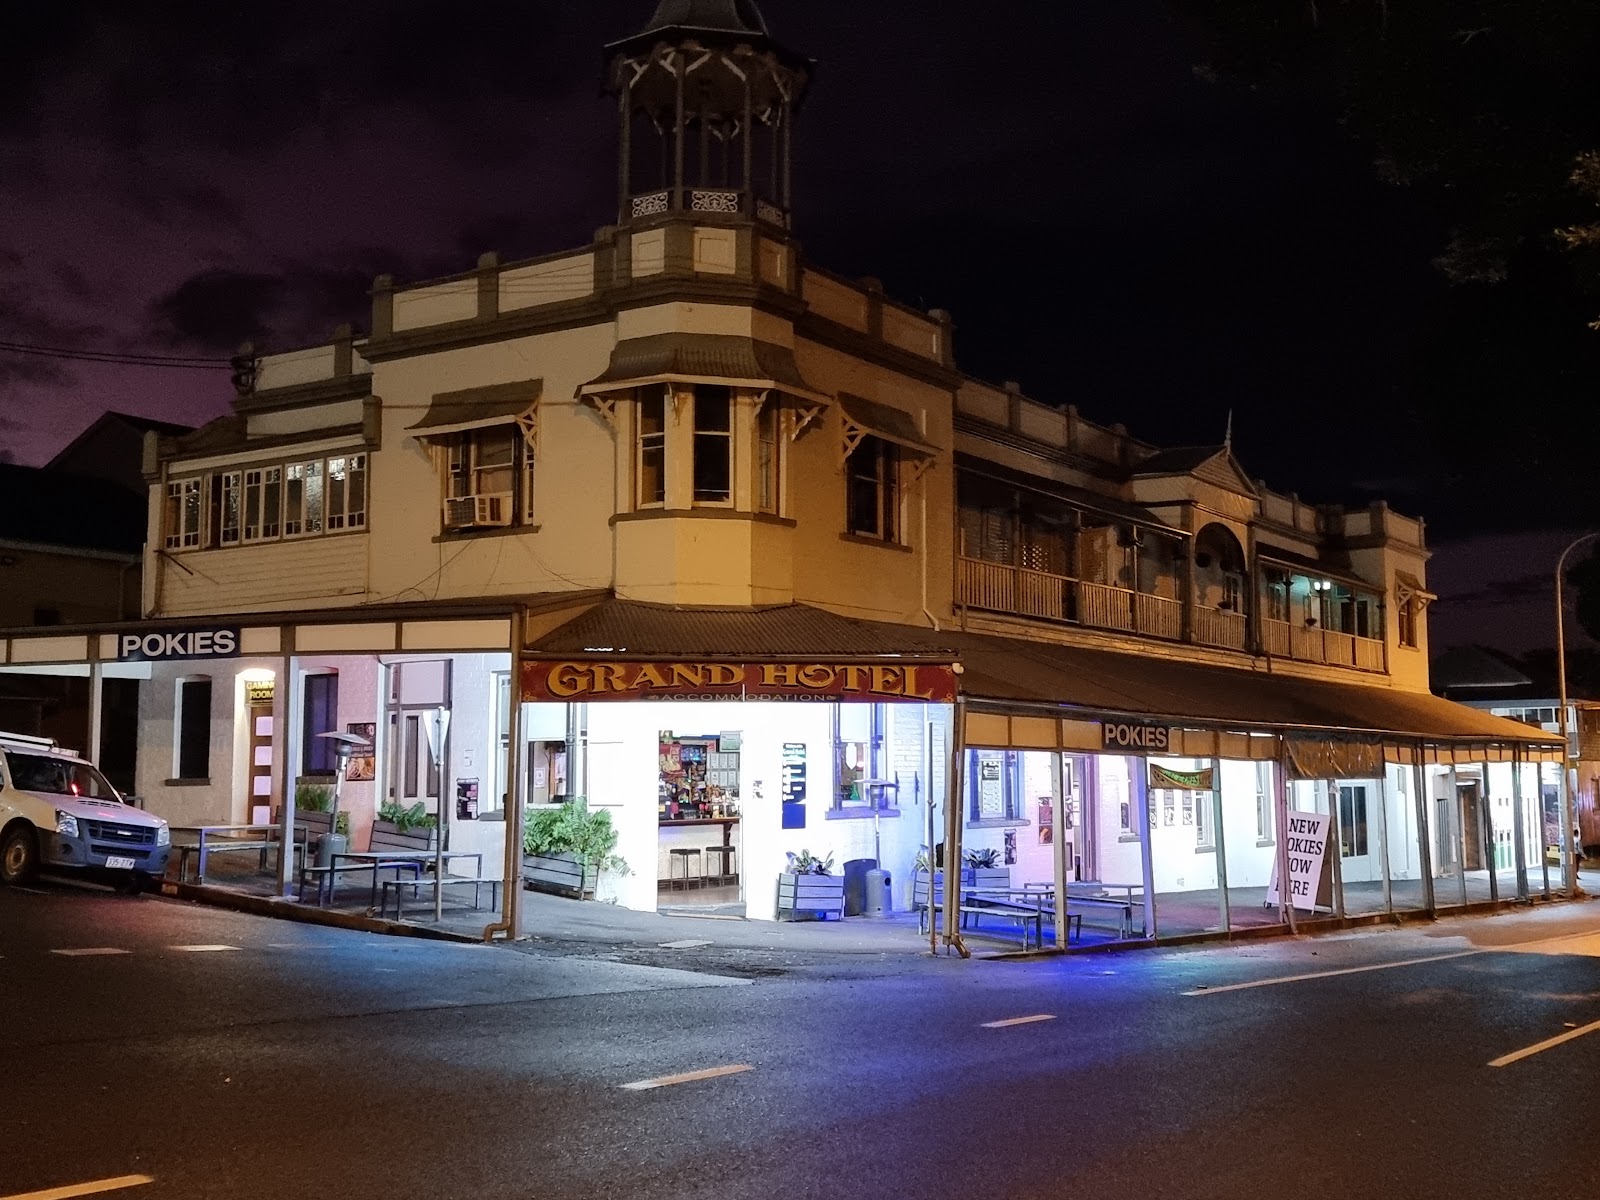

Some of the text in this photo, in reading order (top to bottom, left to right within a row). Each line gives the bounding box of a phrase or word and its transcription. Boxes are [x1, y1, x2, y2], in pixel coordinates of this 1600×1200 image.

[122, 630, 236, 657] POKIES
[546, 663, 934, 700] GRAND HOTEL
[661, 693, 825, 701] ACCOMMODATION
[1104, 723, 1168, 748] POKIES
[1288, 818, 1321, 835] NEW
[1287, 837, 1324, 856] OKIES
[1288, 857, 1313, 874] OW
